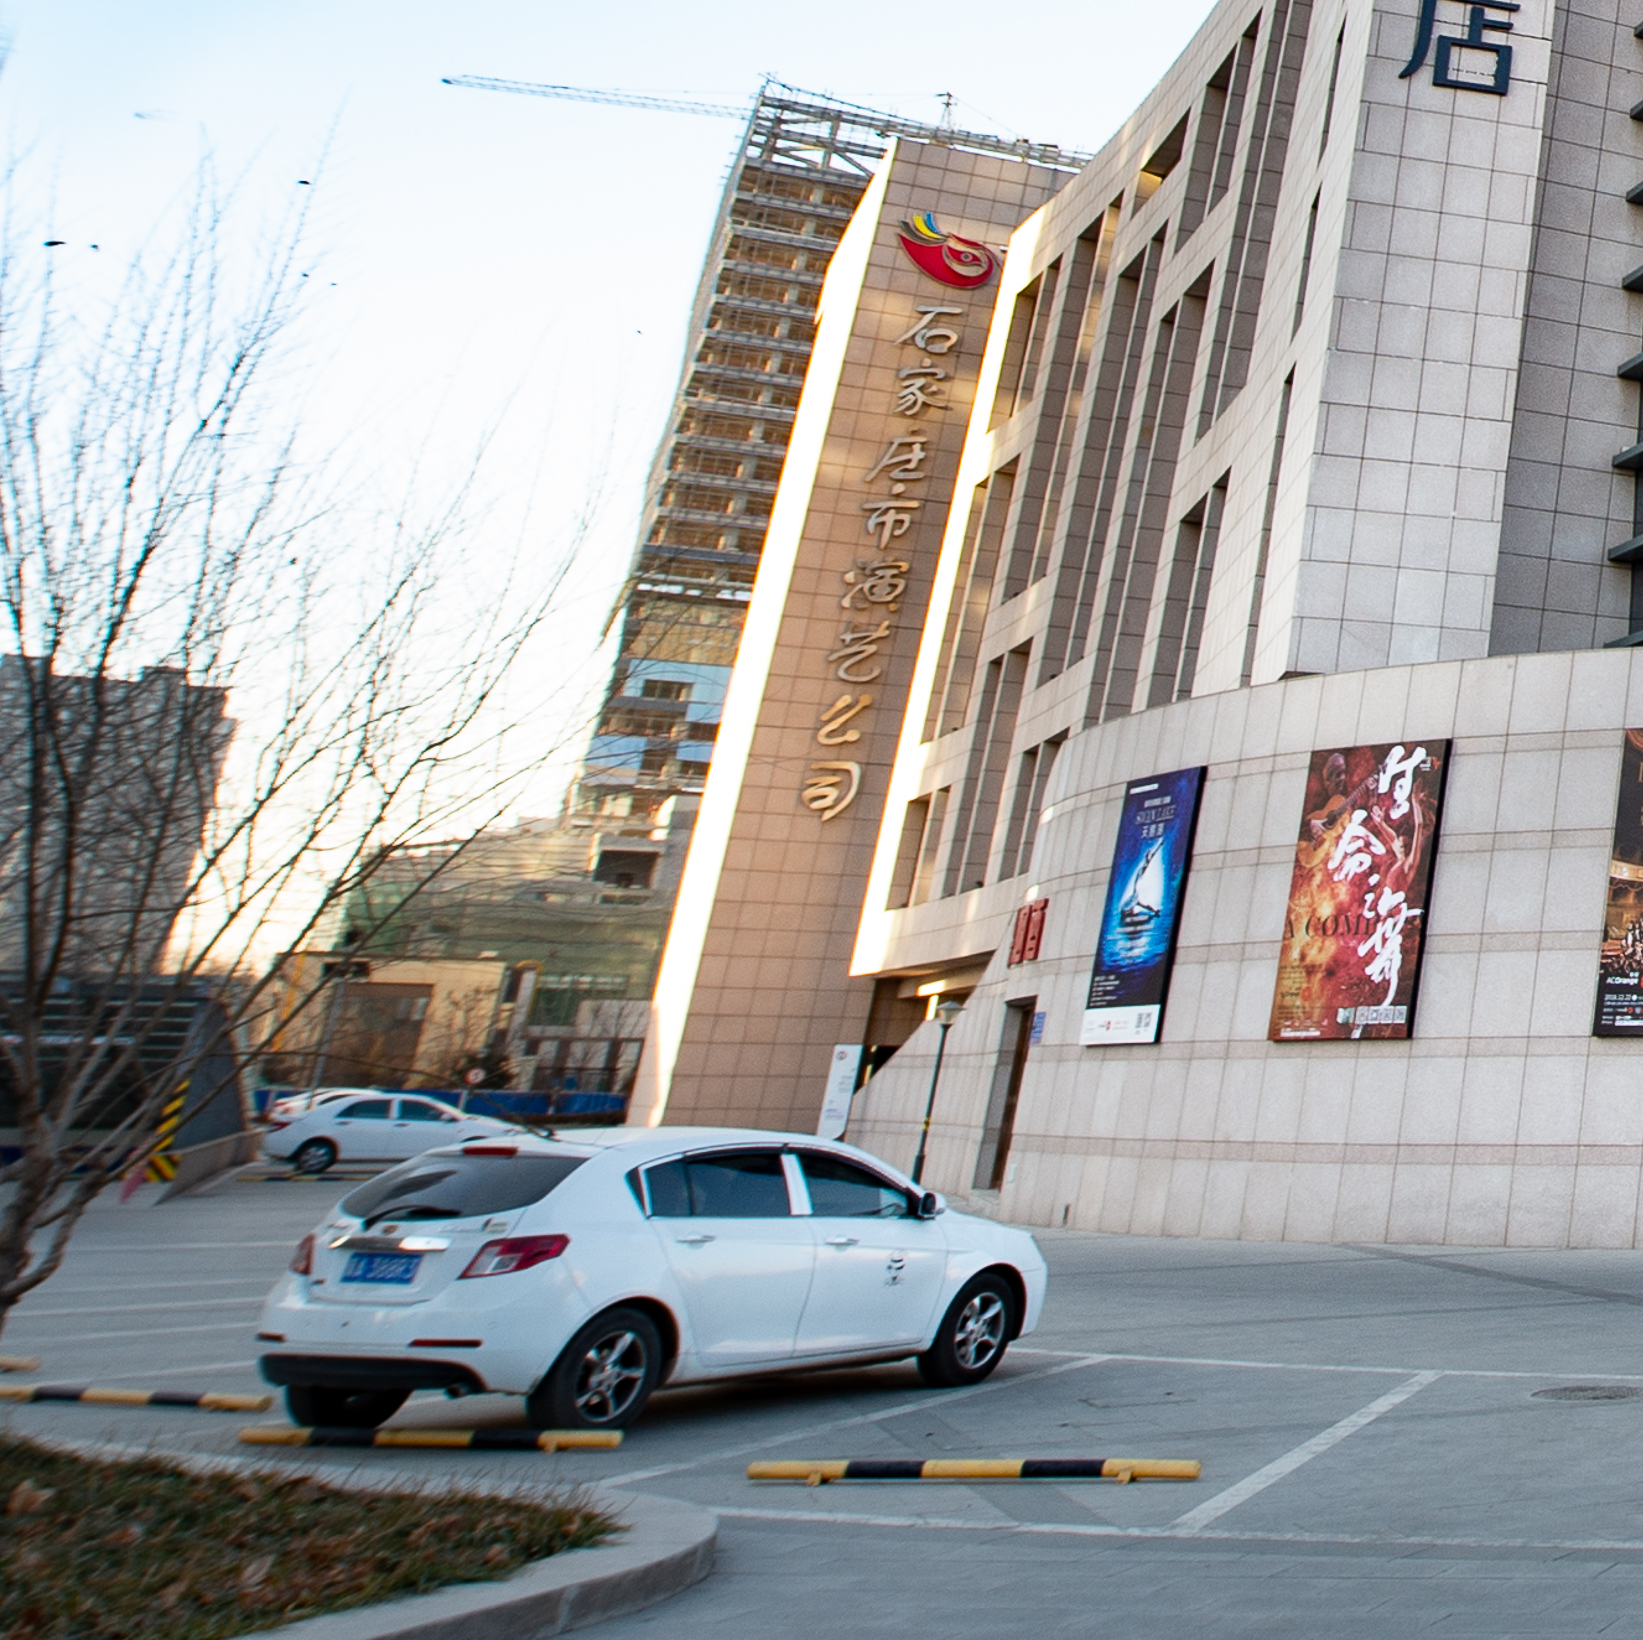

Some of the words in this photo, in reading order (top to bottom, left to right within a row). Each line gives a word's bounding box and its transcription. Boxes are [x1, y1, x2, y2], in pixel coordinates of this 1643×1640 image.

[802, 305, 962, 821] 石家庄市演艺公司
